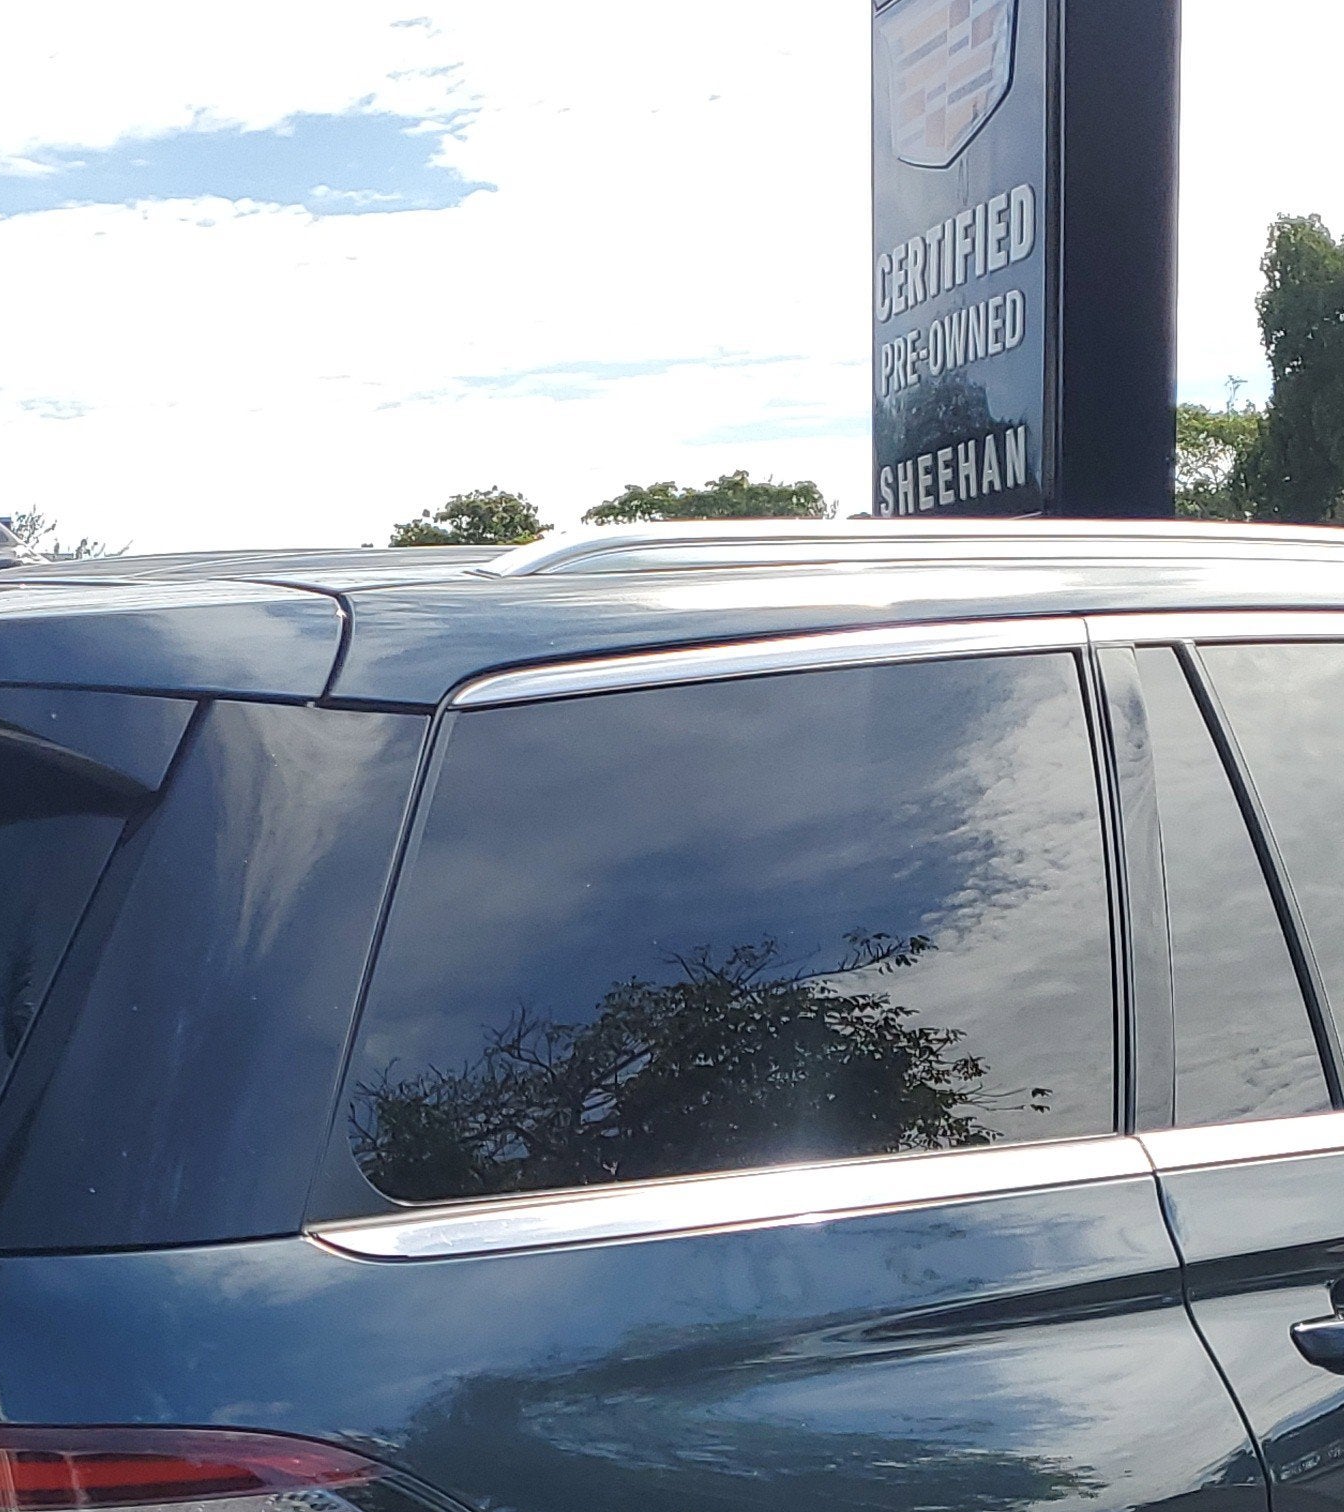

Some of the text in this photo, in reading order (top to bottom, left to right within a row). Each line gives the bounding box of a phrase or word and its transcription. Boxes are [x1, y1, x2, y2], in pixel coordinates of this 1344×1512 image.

[875, 183, 1036, 323] CERTIFIED
[881, 290, 1026, 397] PRE-OWNED
[880, 425, 1026, 518] SHEEHAN
